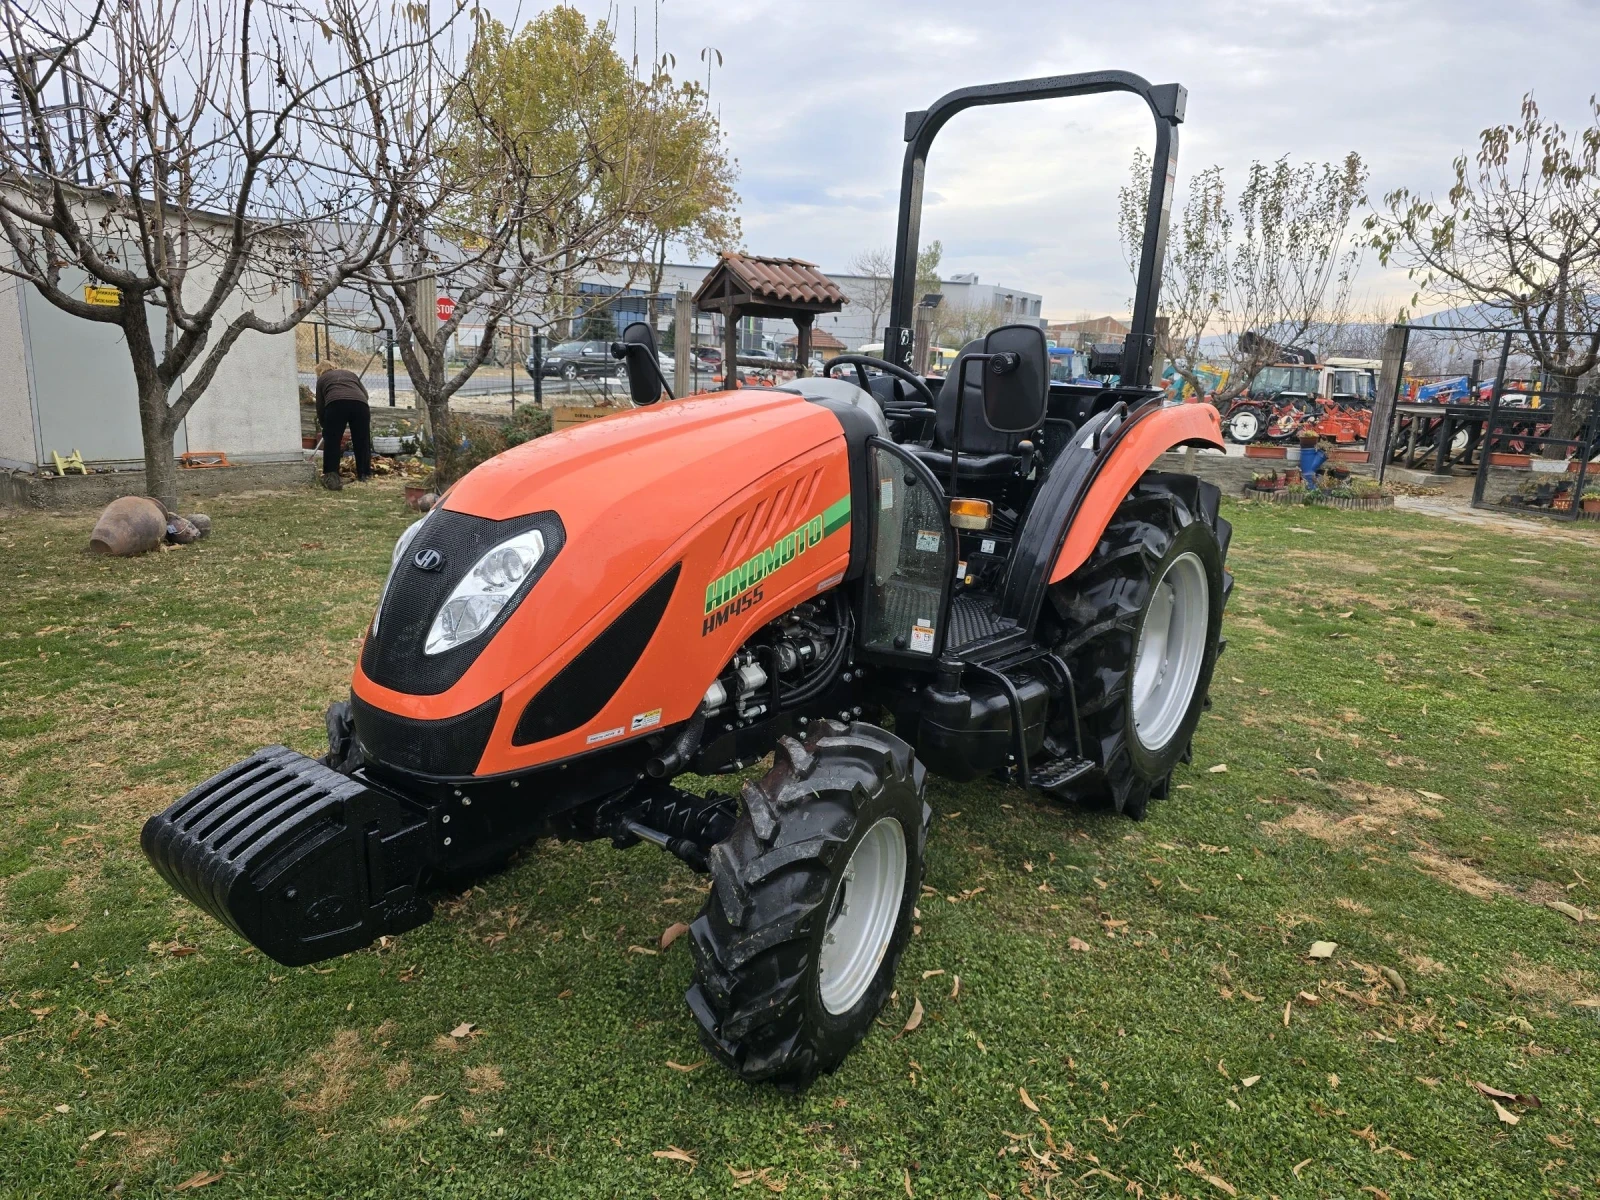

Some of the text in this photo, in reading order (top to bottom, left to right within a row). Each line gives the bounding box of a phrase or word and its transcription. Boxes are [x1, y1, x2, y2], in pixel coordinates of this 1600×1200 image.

[436, 304, 455, 314] STOP
[704, 514, 823, 616] HINOMOTO
[702, 584, 764, 637] HM455
